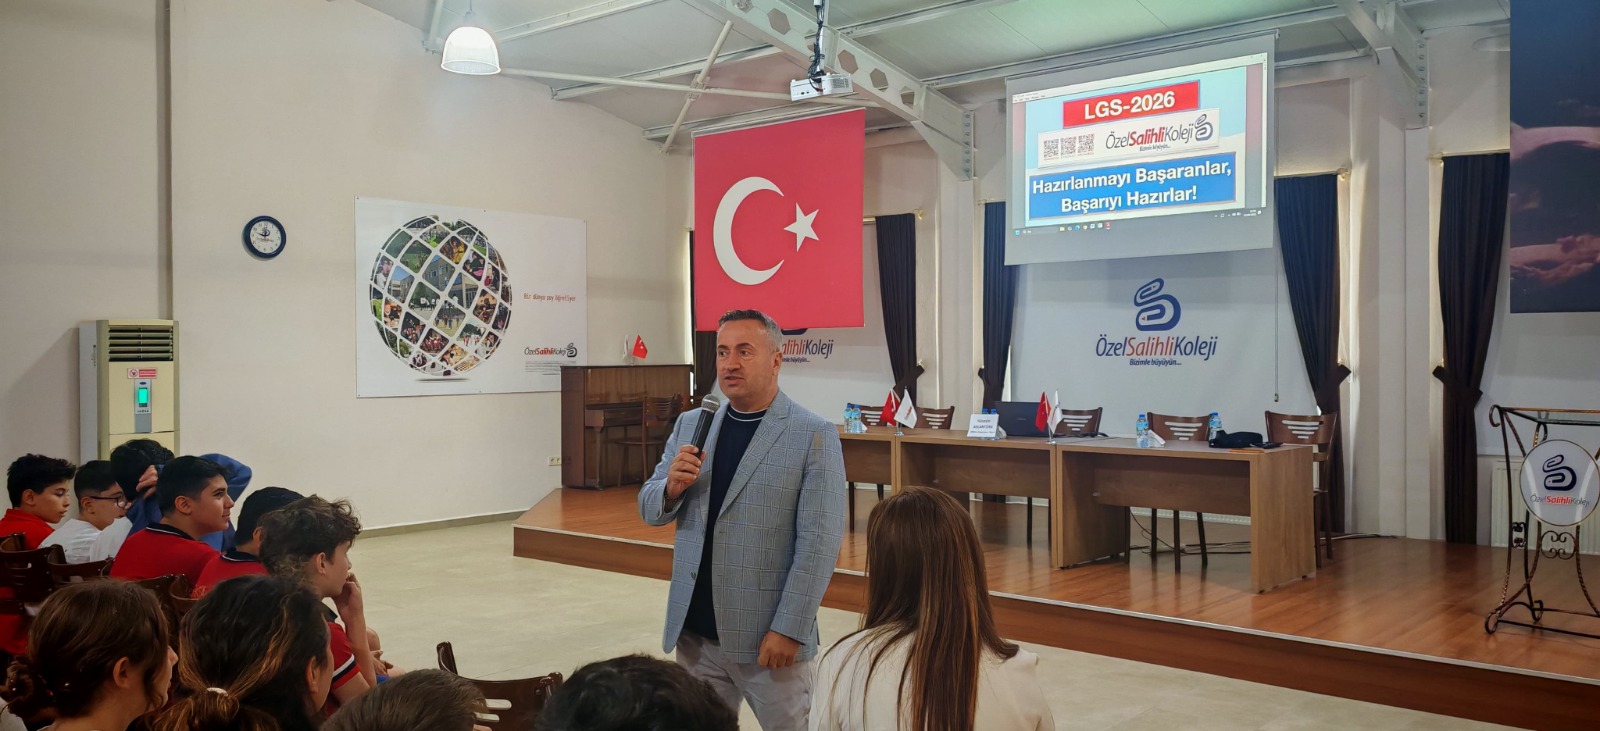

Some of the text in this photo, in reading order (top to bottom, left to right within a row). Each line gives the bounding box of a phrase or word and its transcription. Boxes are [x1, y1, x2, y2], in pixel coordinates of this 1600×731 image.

[1084, 91, 1175, 120] LGS-2026
[1105, 123, 1194, 149] ÖzelSalihliKoleji
[1032, 160, 1232, 194] Hazırlanmayı Başaranlar,
[1061, 185, 1198, 214] Başarıyı Hazırlar!
[782, 339, 834, 360] alihliKoleji
[1095, 334, 1218, 361] ÖzelSalihliKoleji
[1129, 358, 1182, 367] Bizimle büyüyün...
